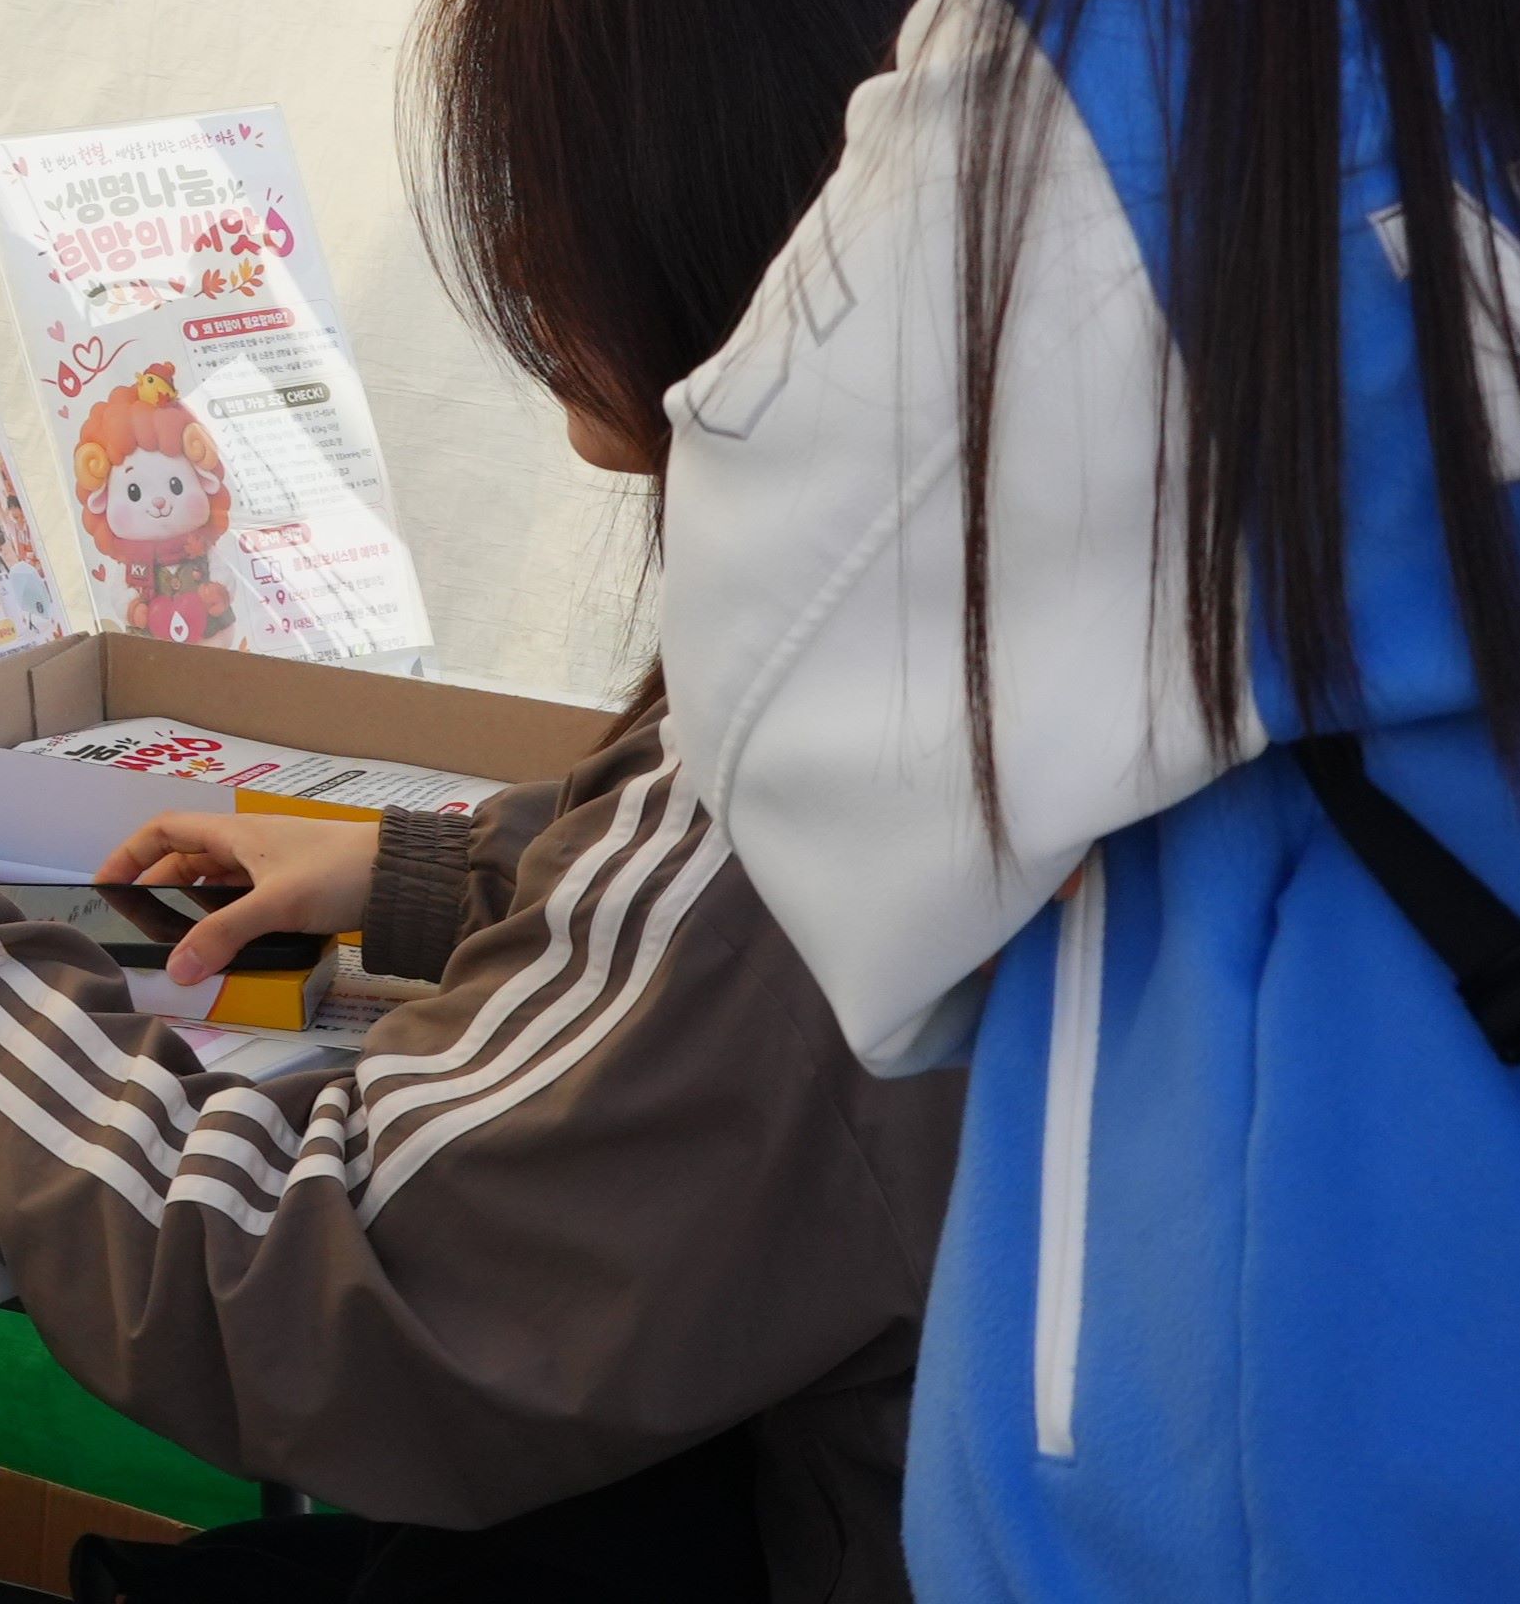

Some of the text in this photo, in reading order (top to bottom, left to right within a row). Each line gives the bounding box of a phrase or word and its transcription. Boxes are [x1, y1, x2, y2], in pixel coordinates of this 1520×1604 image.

[214, 129, 236, 146] 마음
[66, 164, 228, 225] 생명나눔,
[53, 207, 264, 282] 희망의 씨앗
[286, 387, 324, 404] CHECK!
